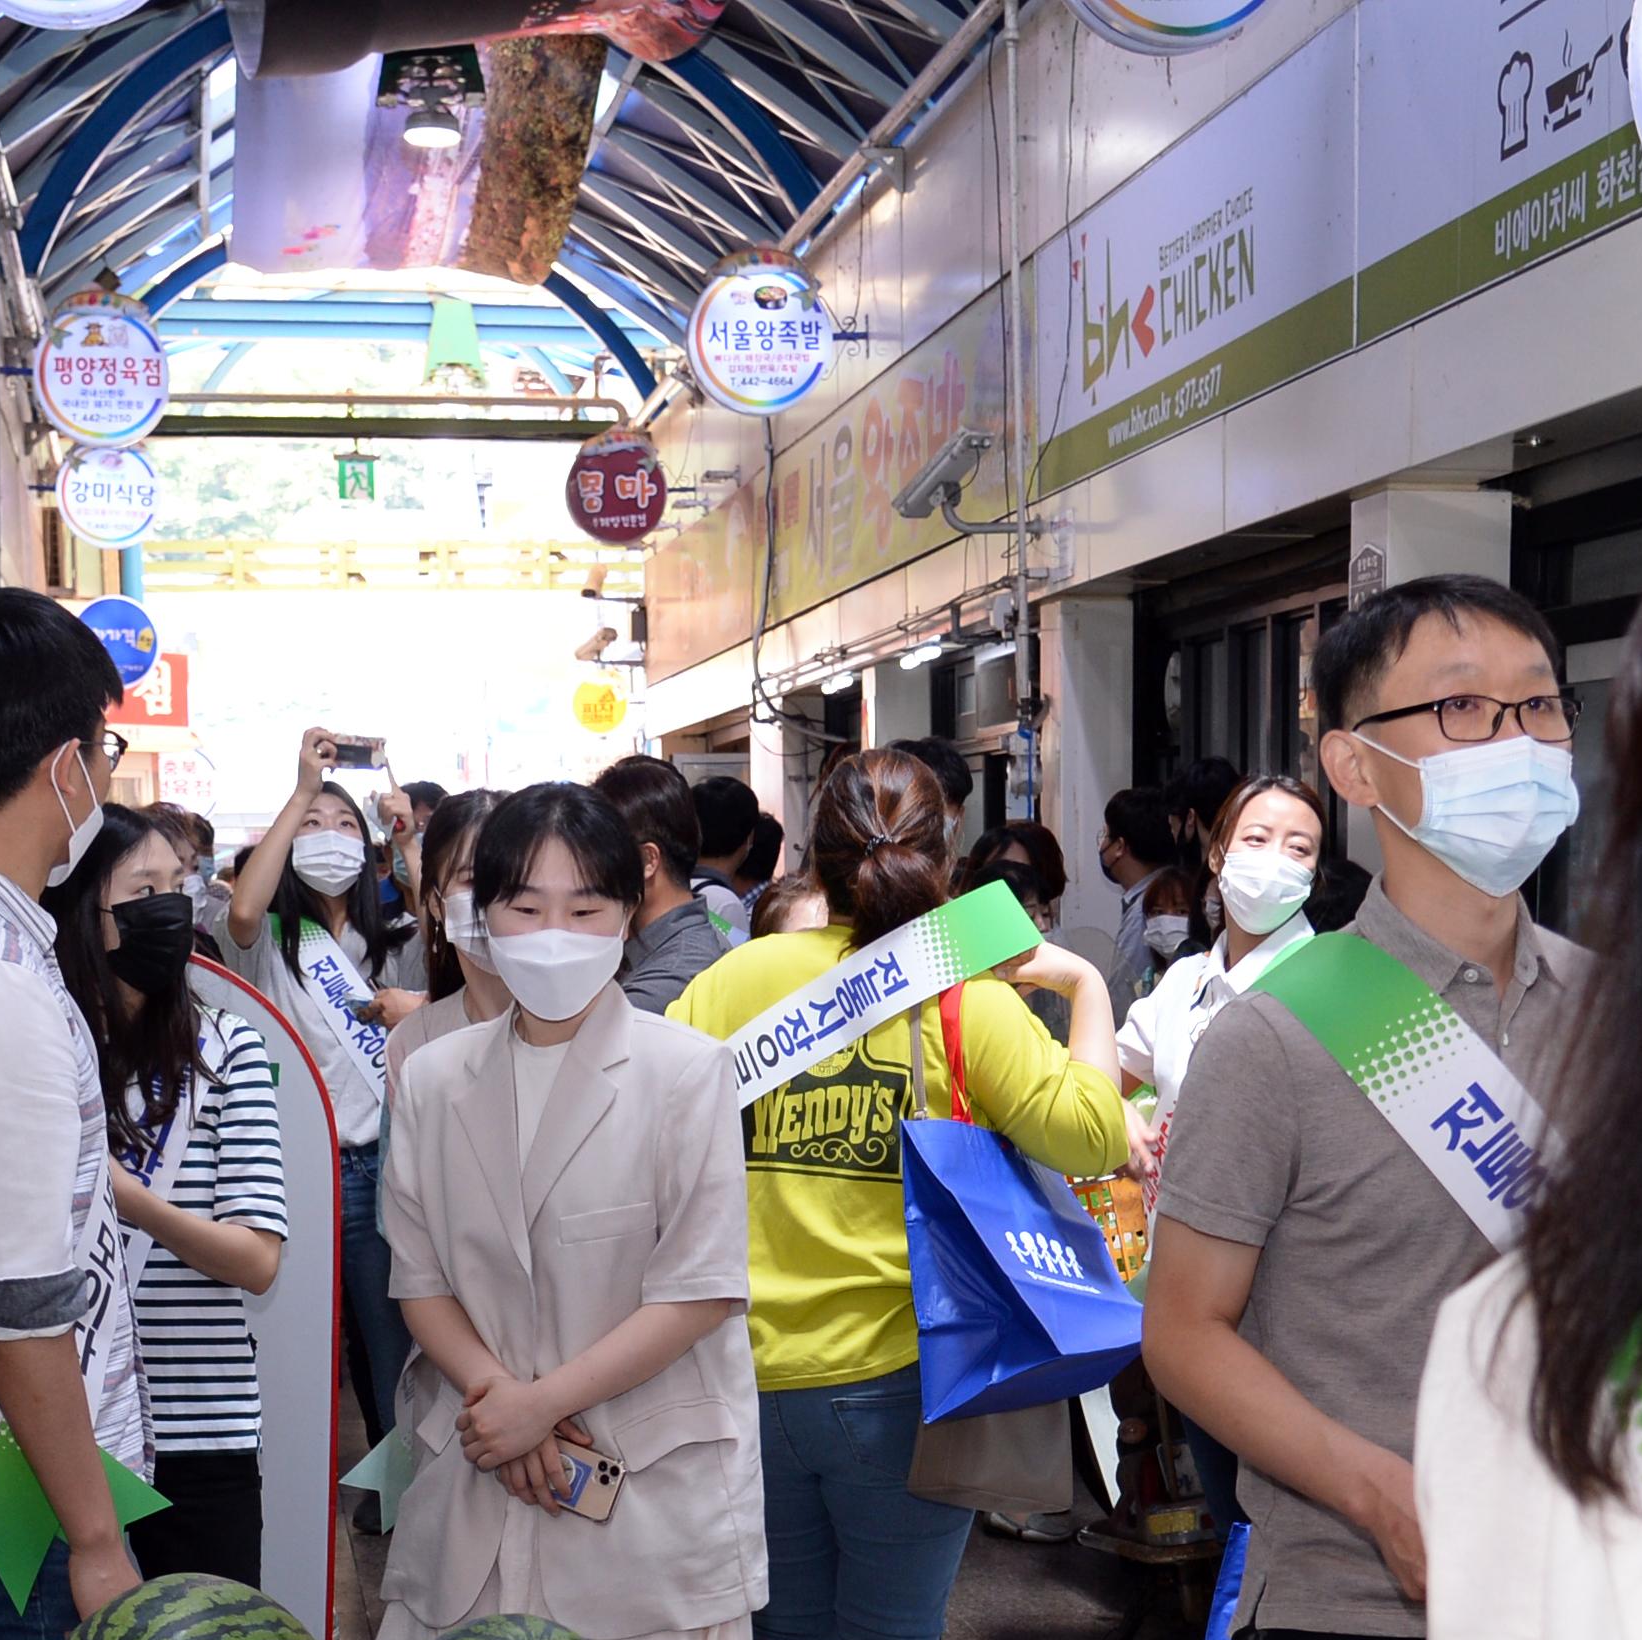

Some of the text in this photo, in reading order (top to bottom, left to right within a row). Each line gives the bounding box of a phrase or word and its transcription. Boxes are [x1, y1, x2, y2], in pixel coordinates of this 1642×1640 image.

[1495, 170, 1587, 260] 비에이치씨
[1159, 224, 1254, 347] CHICKEN
[709, 320, 822, 351] 서울왕족발
[54, 356, 162, 387] 평양정육점
[1108, 392, 1171, 448] www.bhc.co.kr
[71, 480, 156, 508] 강미식당
